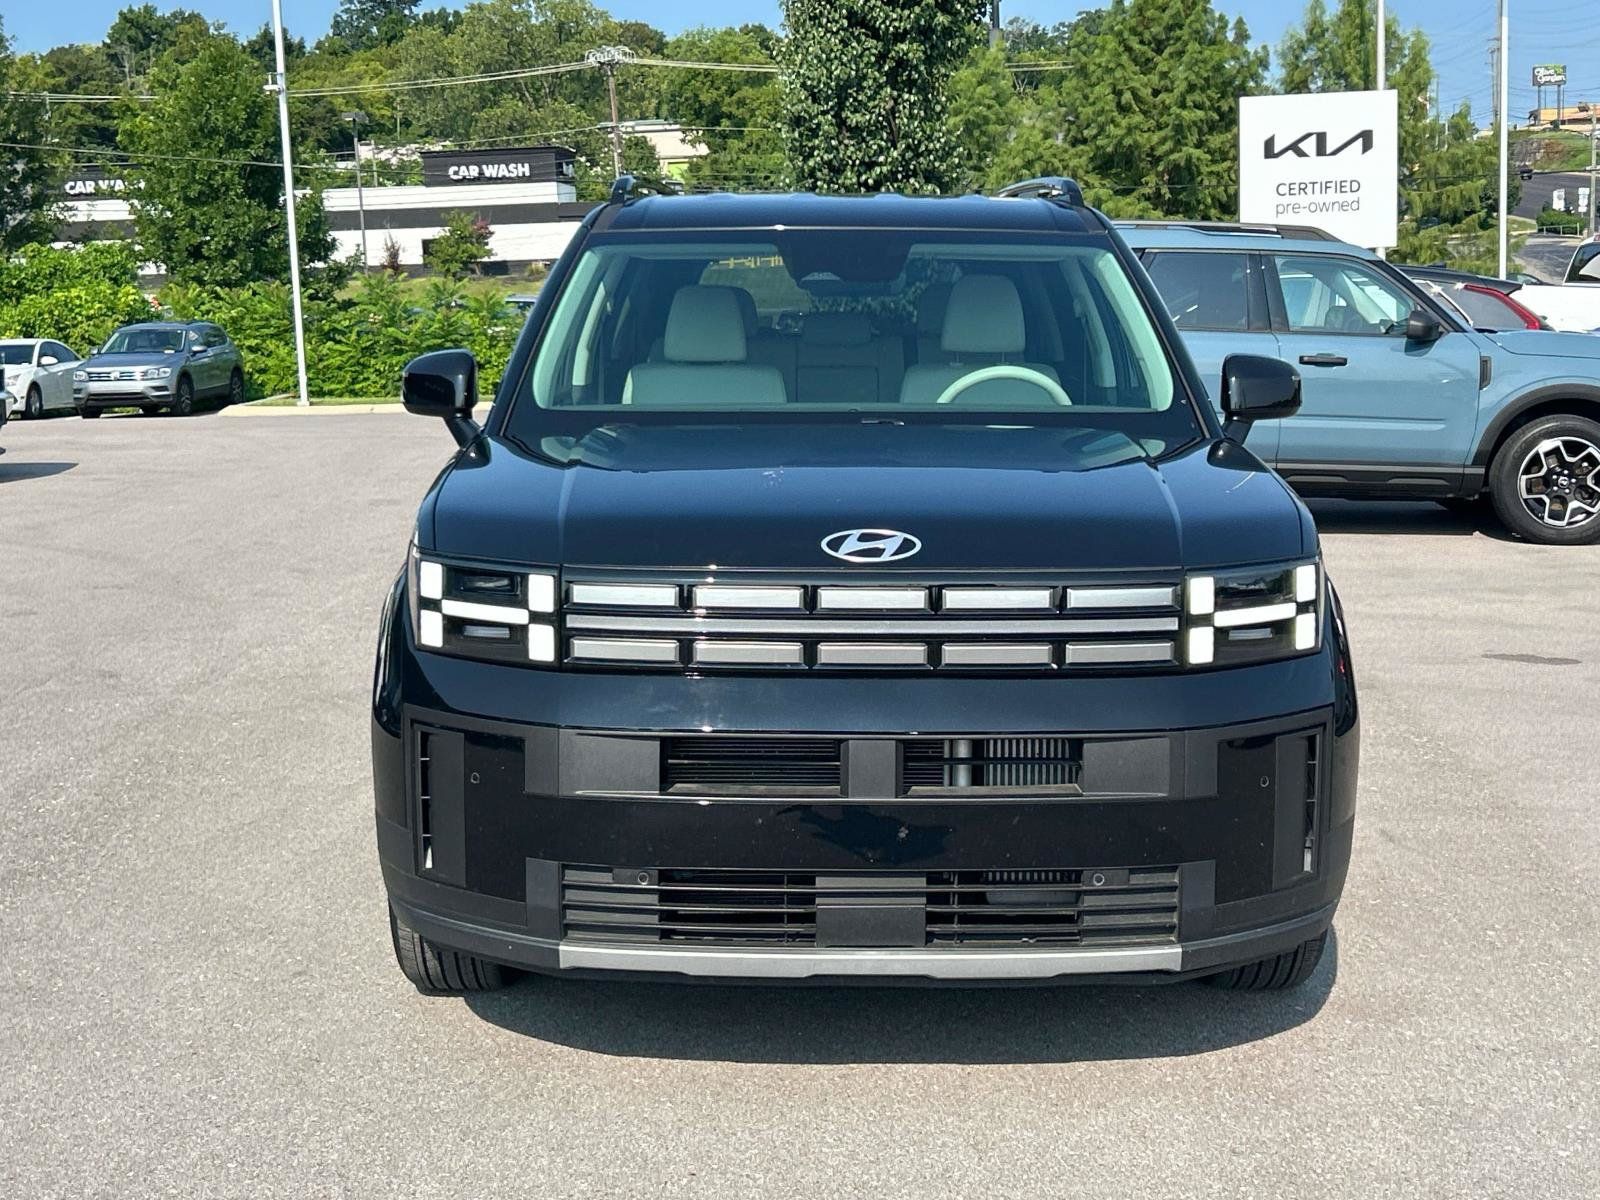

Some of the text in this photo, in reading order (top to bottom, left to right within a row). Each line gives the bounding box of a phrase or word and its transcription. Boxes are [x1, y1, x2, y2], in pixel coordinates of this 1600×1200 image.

[1264, 129, 1373, 160] KIA
[448, 163, 530, 180] CAR WASH
[64, 179, 146, 195] CAR WA
[1276, 180, 1361, 197] CERTIFIED
[1276, 197, 1360, 217] pre-owned
